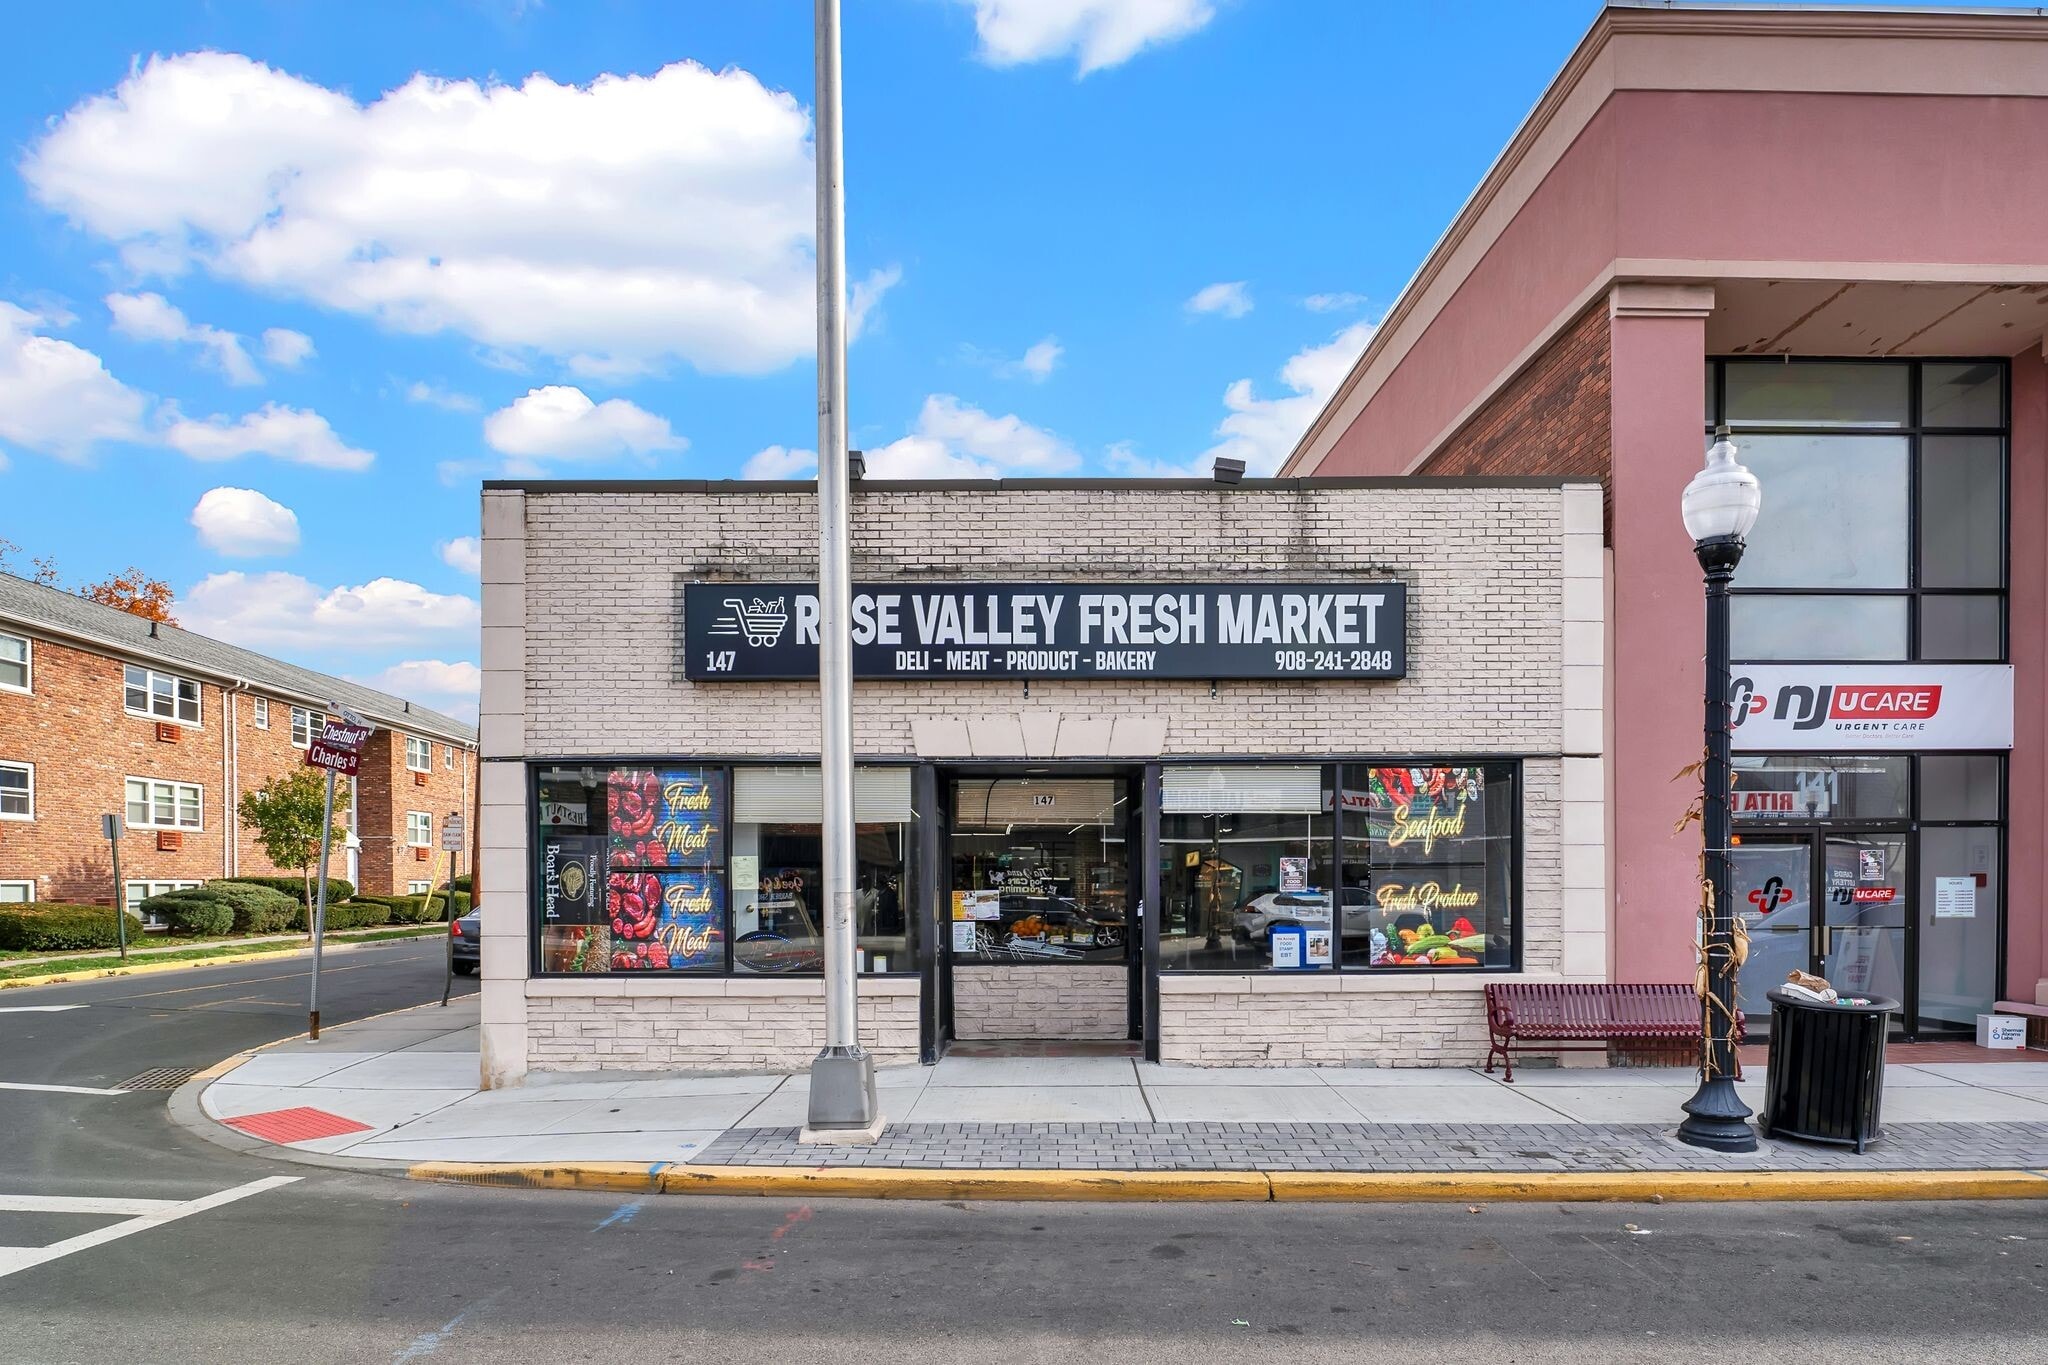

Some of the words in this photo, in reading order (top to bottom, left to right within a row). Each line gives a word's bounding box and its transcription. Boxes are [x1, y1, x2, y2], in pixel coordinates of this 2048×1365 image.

[794, 594, 902, 645] RSE
[911, 594, 1065, 645] VALLEY
[1078, 593, 1206, 645] FRESH
[1216, 593, 1386, 645] MARKET
[706, 650, 737, 672] 147
[895, 650, 930, 671] DELI
[946, 650, 990, 671] MEAT
[1006, 650, 1079, 671] PRODUCT
[1095, 650, 1157, 671] BAKERY
[1274, 650, 1393, 671] 908-241-2848
[1837, 691, 1931, 712] UCARE
[322, 724, 360, 745] Chestnut
[358, 730, 368, 741] St
[1834, 723, 1889, 731] URGENT
[1893, 723, 1926, 731] CARE
[311, 745, 348, 770] Charles
[349, 755, 357, 768] St
[664, 782, 712, 816] Fresh
[1034, 795, 1054, 805] 147
[1795, 771, 1838, 805] 141
[658, 821, 719, 856] Meat
[1388, 804, 1467, 858] Seafood
[588, 855, 597, 877] Proudly
[546, 883, 560, 918] Head
[665, 884, 713, 919] Fresh
[1376, 884, 1418, 917] Fresh
[1418, 881, 1479, 914] Produce
[1856, 889, 1892, 899] UCARE
[660, 923, 720, 957] Meat
